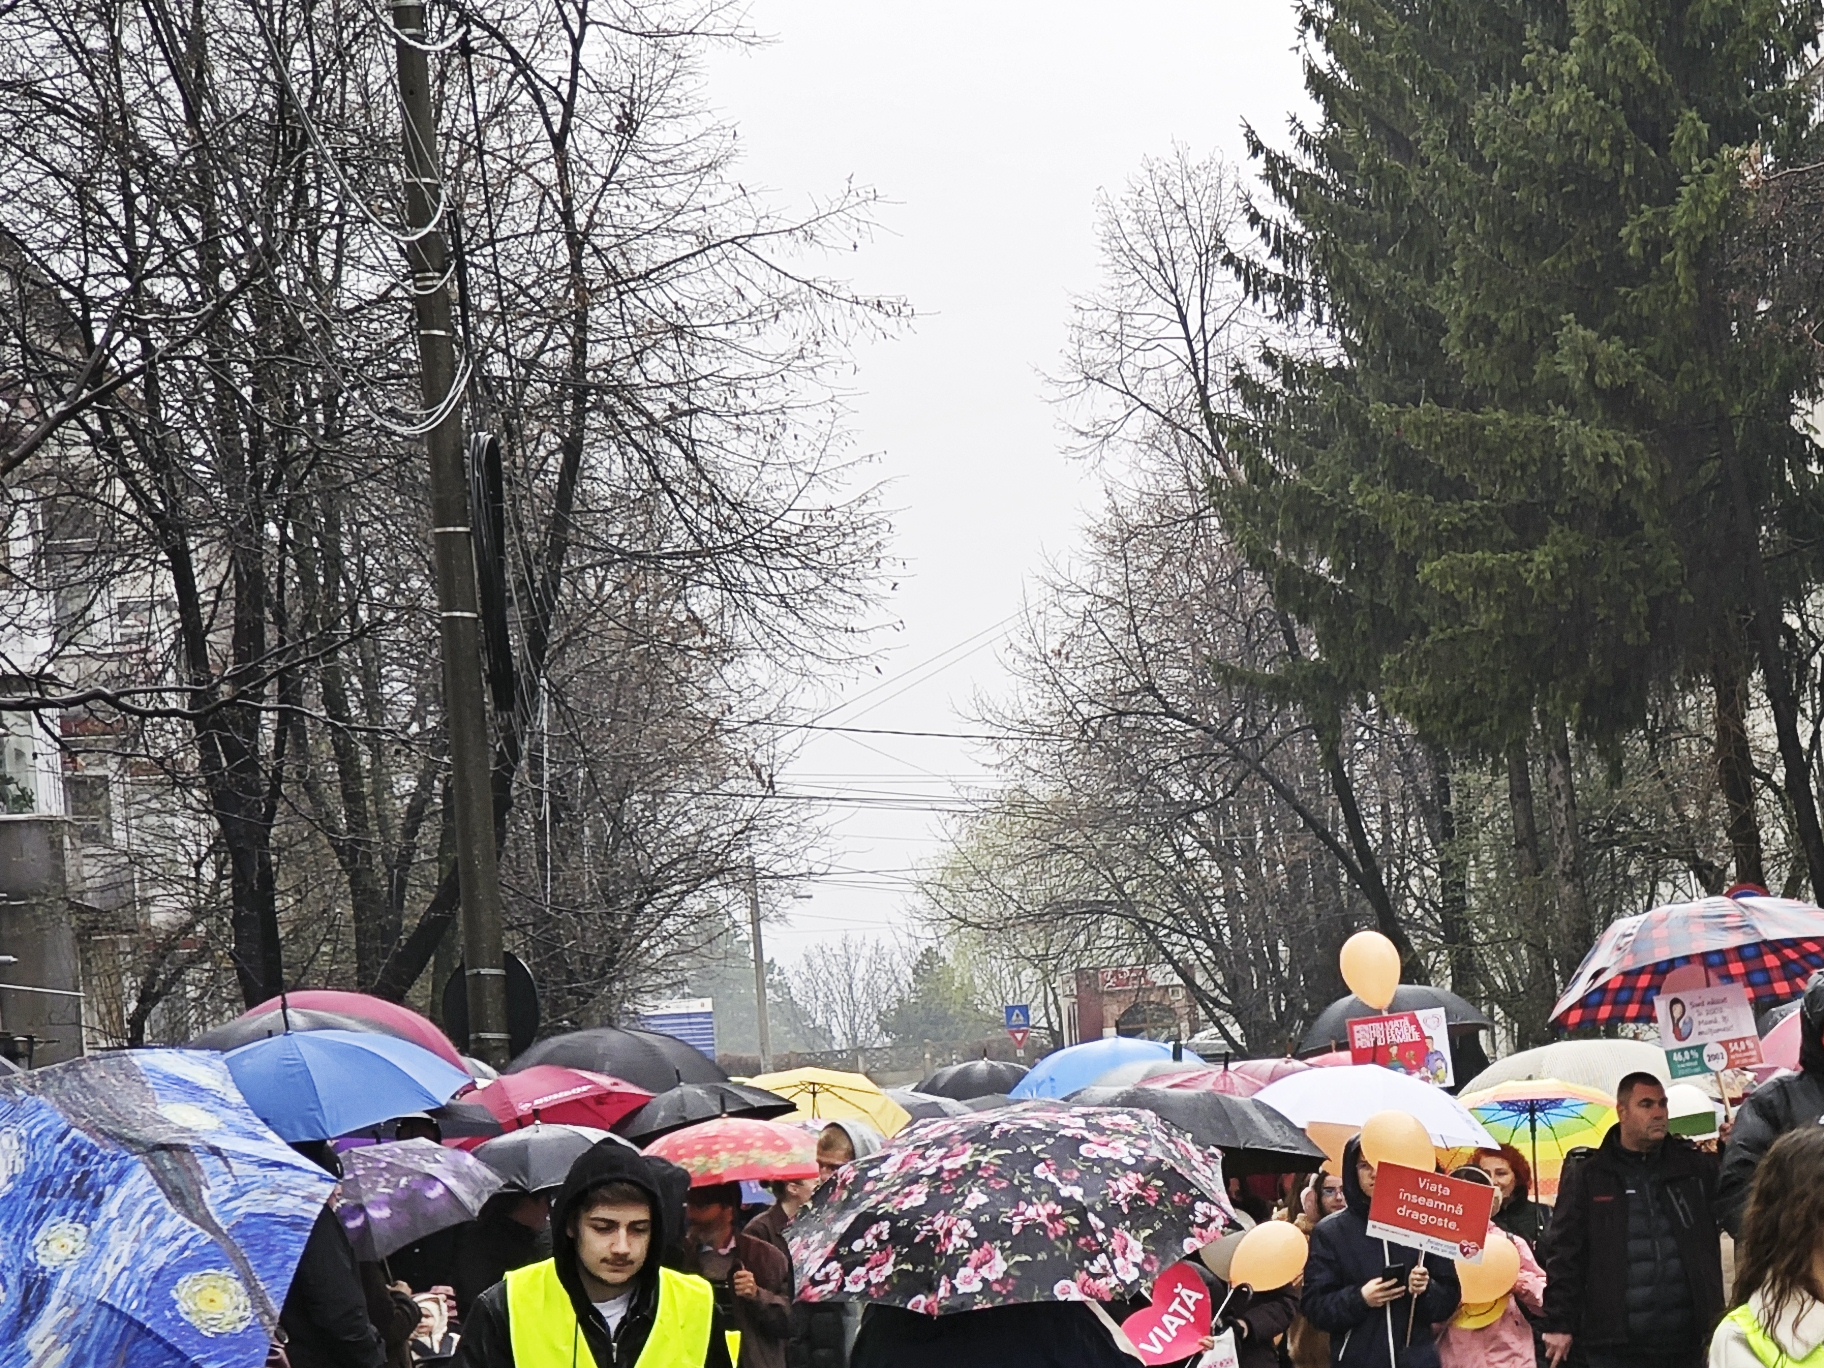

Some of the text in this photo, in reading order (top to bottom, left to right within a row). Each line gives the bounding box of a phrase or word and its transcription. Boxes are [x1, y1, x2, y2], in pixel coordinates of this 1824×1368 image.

[1417, 1176, 1451, 1197] Viața
[1398, 1188, 1463, 1216] înseamnă
[1396, 1204, 1460, 1232] dragoste.
[1138, 1282, 1205, 1356] VIAȚĂ
